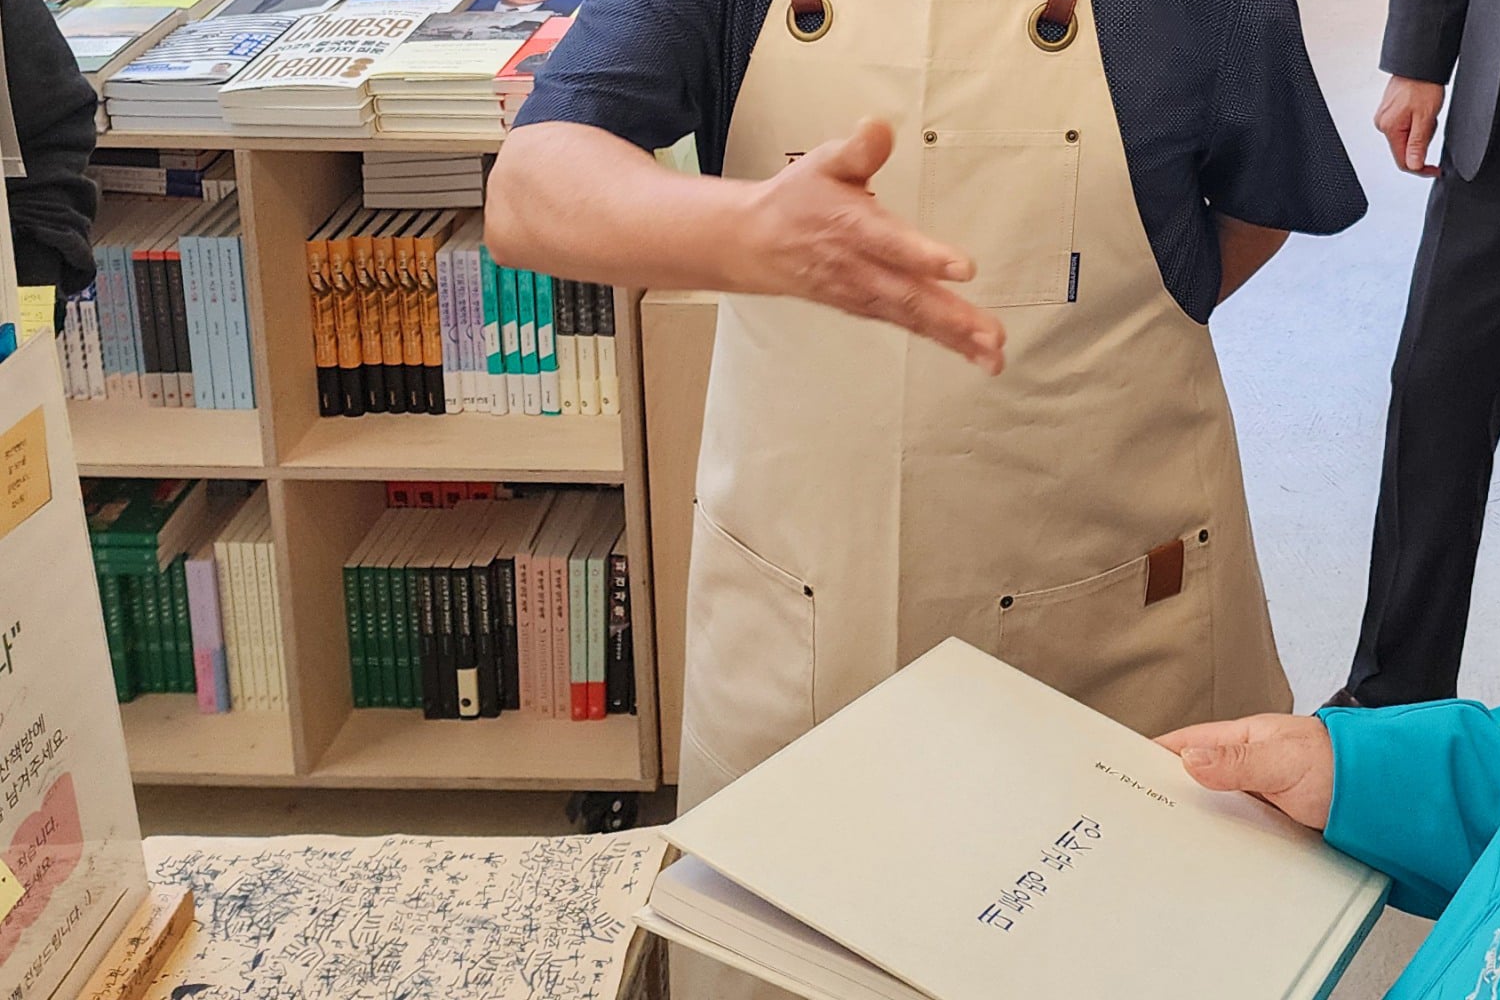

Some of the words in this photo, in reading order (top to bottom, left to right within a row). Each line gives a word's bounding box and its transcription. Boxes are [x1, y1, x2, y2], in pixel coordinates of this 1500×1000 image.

[284, 14, 413, 43] Chinese
[238, 53, 353, 82] Dream
[1120, 775, 1145, 795] 사진
[1144, 786, 1178, 809] 5년의
[976, 869, 1048, 932] 대통령
[1040, 815, 1104, 872] 문재인
